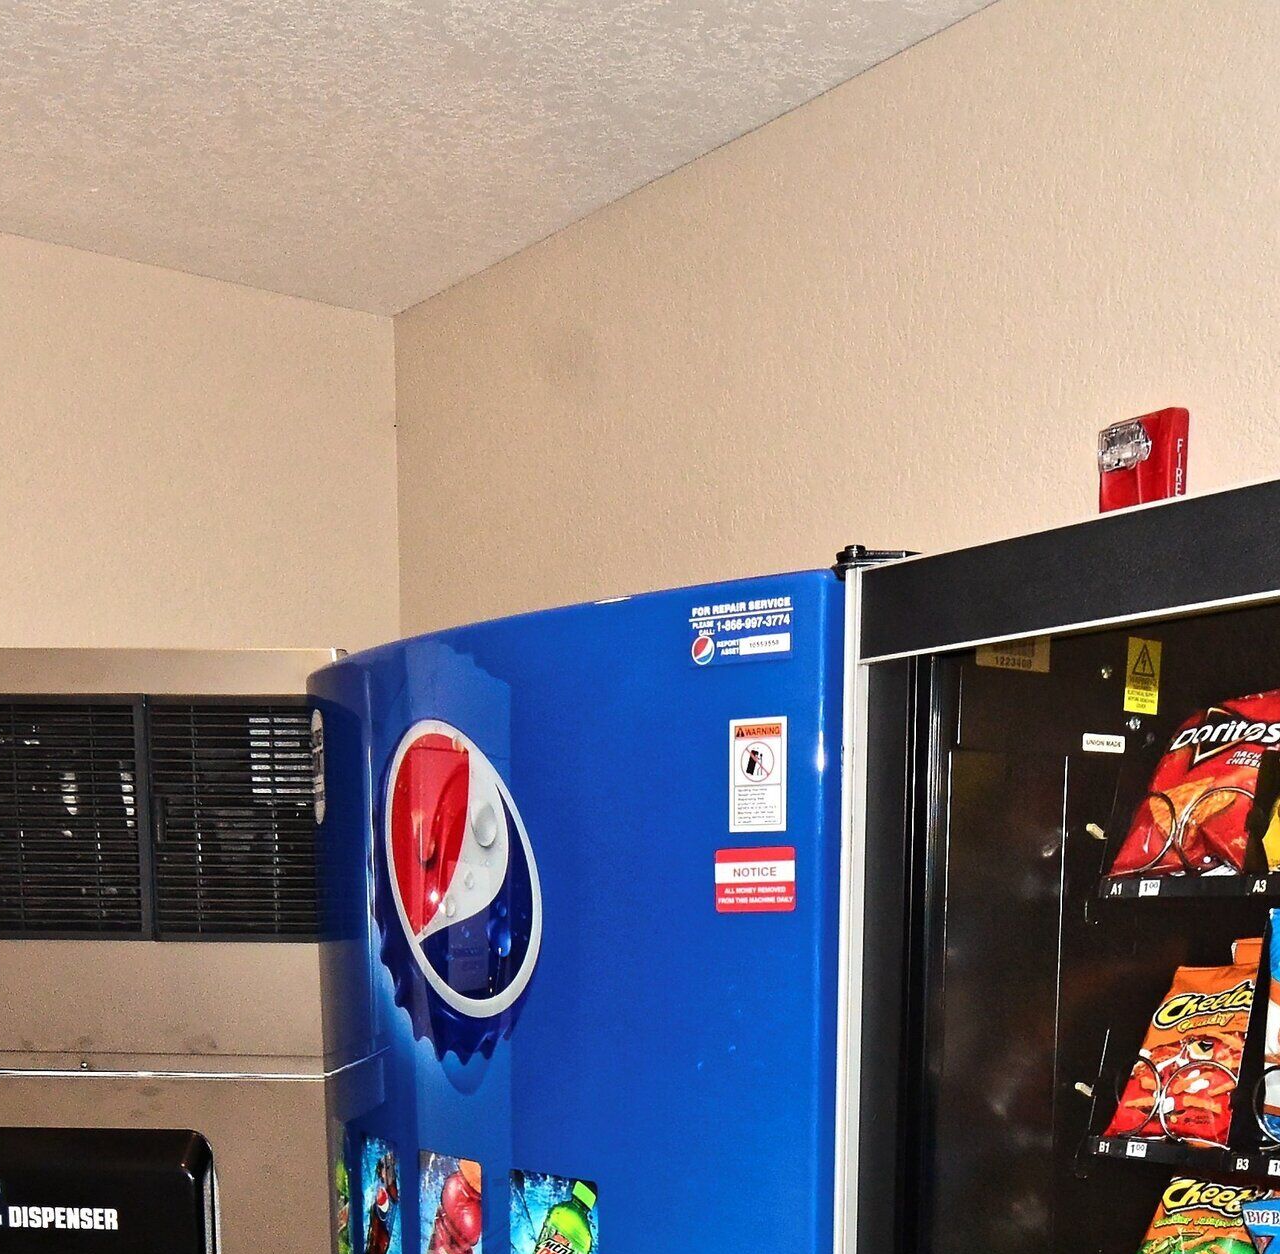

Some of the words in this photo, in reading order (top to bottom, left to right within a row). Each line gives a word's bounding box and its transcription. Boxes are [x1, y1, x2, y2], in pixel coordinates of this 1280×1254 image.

[1175, 438, 1183, 496] FIRE
[692, 606, 711, 617] FOR
[712, 601, 746, 614] REPAIR
[748, 596, 791, 611] SERVICE
[692, 620, 714, 629] PLEASE
[716, 613, 791, 632] 1-866-997-3774
[745, 727, 780, 736] WARNING
[733, 867, 777, 877] NOTICE
[1110, 882, 1123, 896] A1
[1252, 879, 1267, 893] A3
[1153, 980, 1254, 1029] Cheeto
[1236, 1158, 1249, 1171] B3
[8, 1206, 119, 1230] DISPENSER
[1248, 1211, 1271, 1225] BIG
